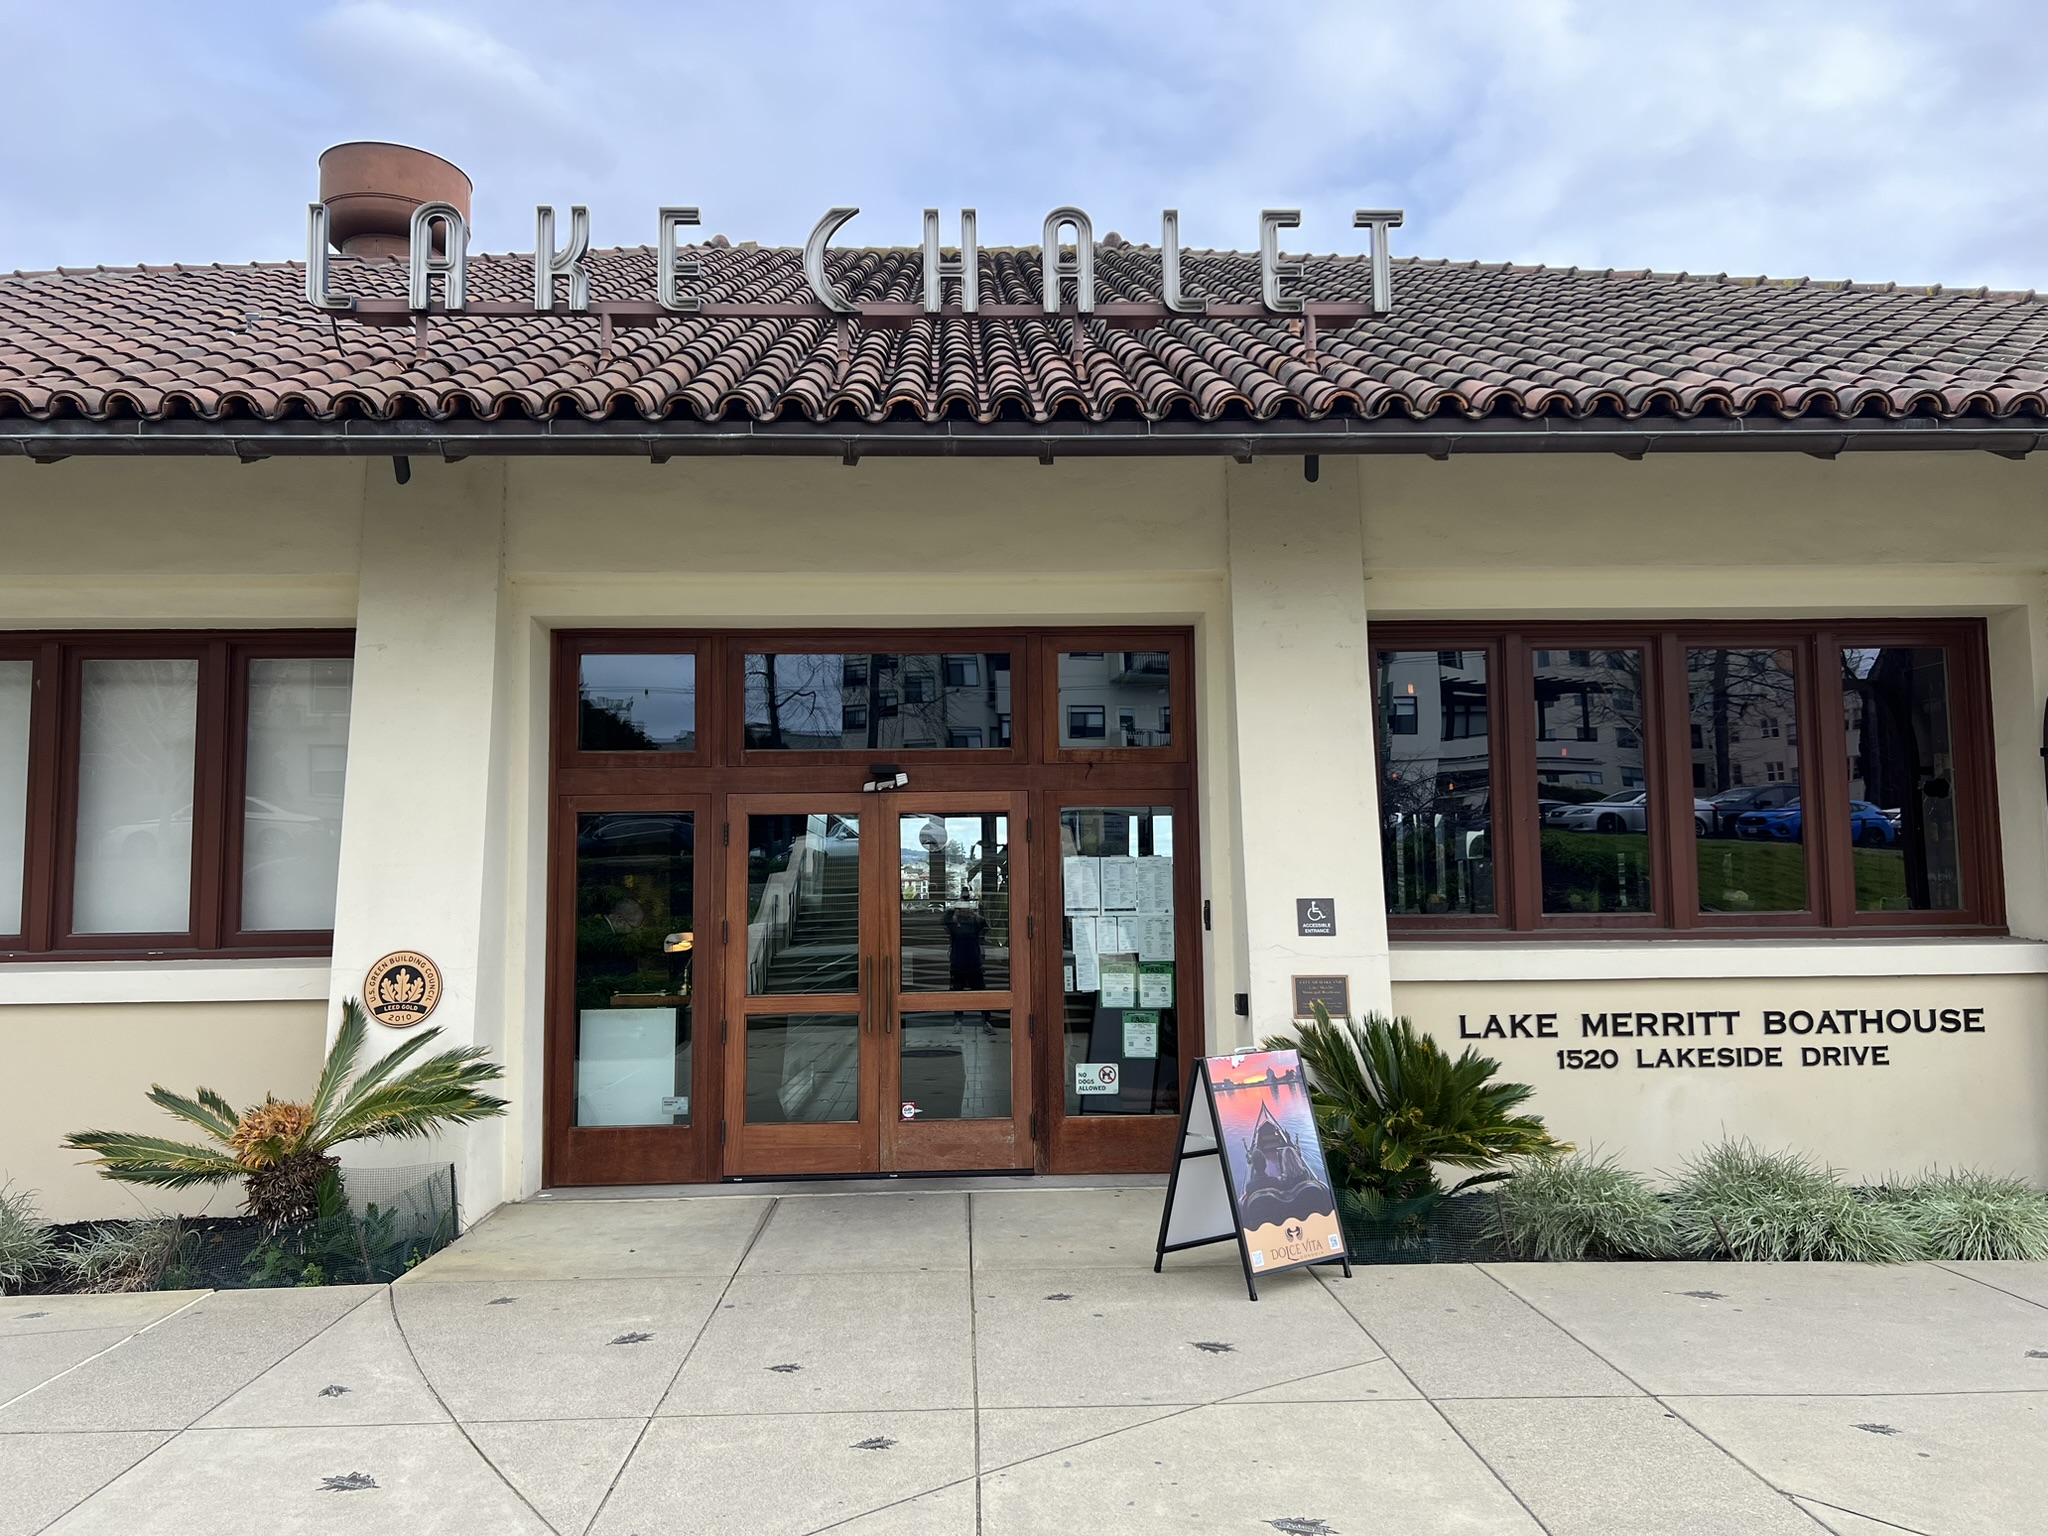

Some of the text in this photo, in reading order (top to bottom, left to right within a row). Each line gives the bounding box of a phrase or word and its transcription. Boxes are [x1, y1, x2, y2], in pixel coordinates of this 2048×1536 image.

[305, 201, 1405, 316] LAKE CHALET
[369, 961, 388, 987] GREEN
[389, 955, 427, 969] BUILDING
[424, 967, 436, 1002] COUNCIL
[388, 1013, 412, 1022] 2010
[1459, 1007, 1986, 1039] LAKE MERRITT BOATHOUSE
[1556, 1045, 1890, 1070] 1520 LAKESIDE DRIVE
[1271, 1238, 1323, 1261] DOLCE VITA
